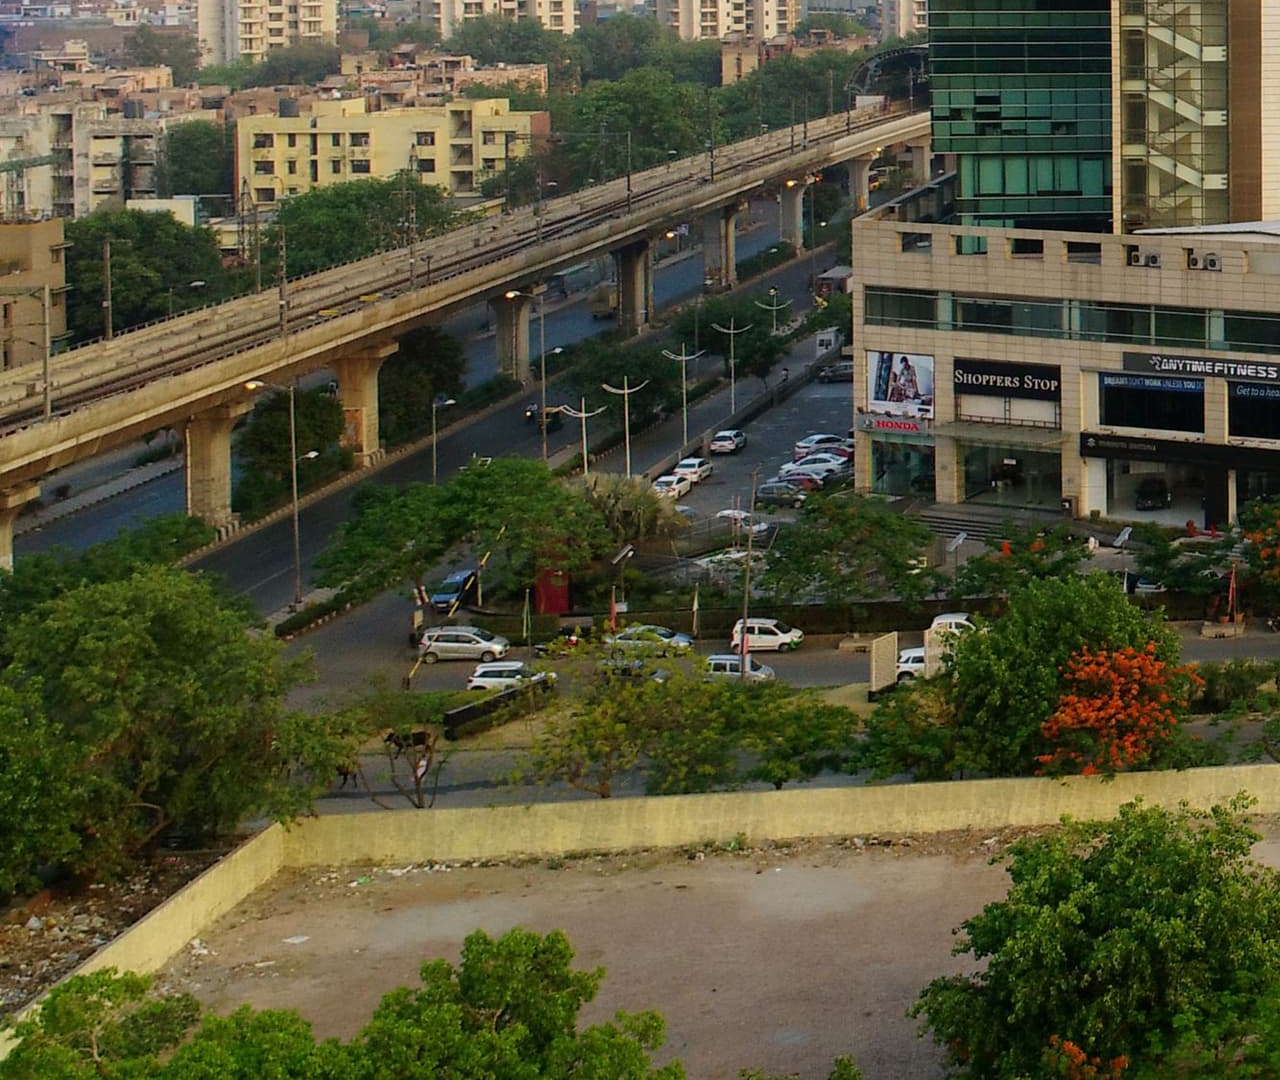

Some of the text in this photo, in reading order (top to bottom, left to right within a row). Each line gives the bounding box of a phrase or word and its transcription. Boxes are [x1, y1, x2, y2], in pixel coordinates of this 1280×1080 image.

[1160, 359, 1278, 379] ANYTIME FITNESS
[954, 369, 1059, 391] SHOPPERS STOP
[1236, 385, 1250, 396] Get
[1251, 387, 1259, 396] to
[875, 420, 919, 432] HONDA
